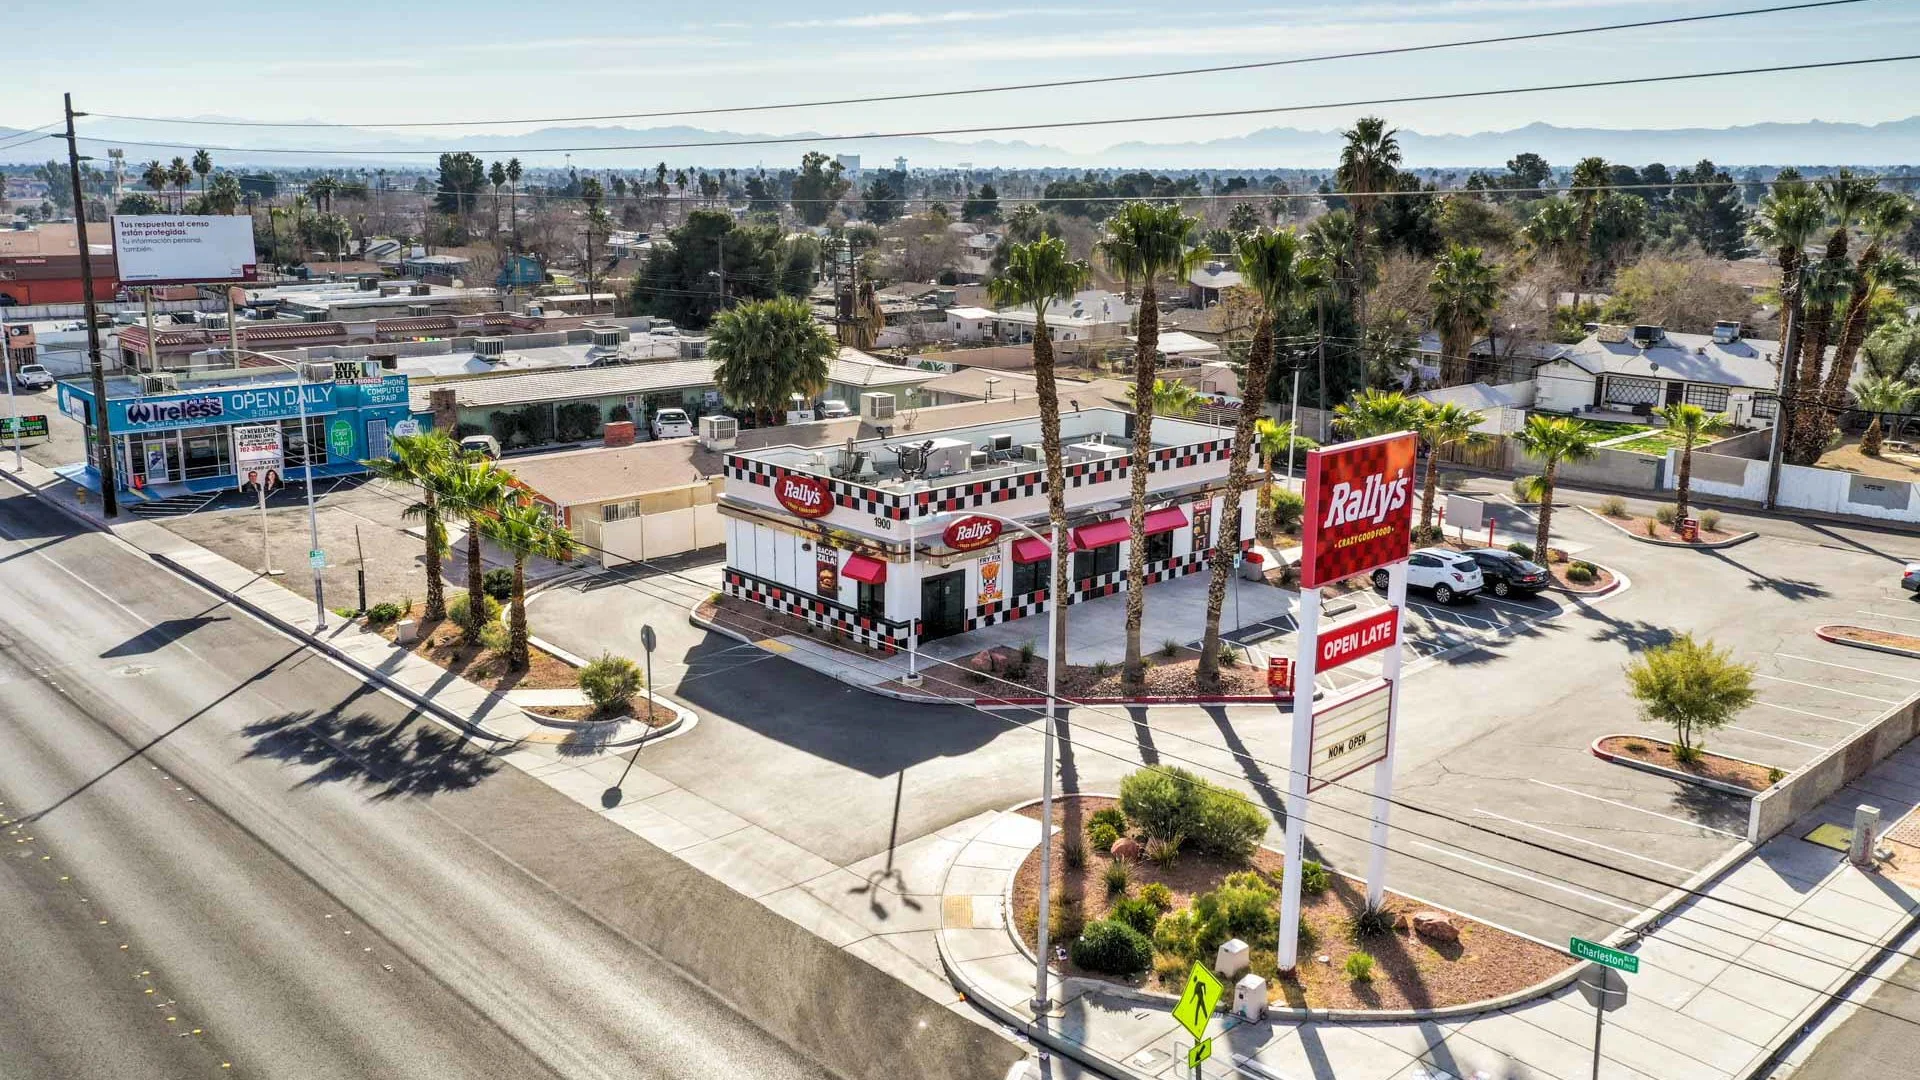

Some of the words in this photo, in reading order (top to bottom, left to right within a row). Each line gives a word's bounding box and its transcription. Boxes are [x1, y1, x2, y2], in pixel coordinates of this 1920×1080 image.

[120, 221, 133, 229] Tus
[134, 221, 175, 229] respuestas
[131, 236, 172, 244] información
[334, 362, 356, 371] WE
[334, 370, 360, 379] BUY
[367, 386, 405, 396] COMPUTER
[231, 391, 280, 410] OPEN
[284, 386, 333, 406] DAILY
[371, 393, 397, 403] REPAIR
[783, 480, 821, 506] Rally's
[1323, 468, 1409, 529] Rally's
[874, 517, 891, 530] 1900
[955, 520, 994, 541] Rally's
[817, 546, 838, 558] BACON
[817, 553, 837, 566] ZILLA!
[1323, 634, 1359, 661] OPEN
[1361, 620, 1392, 646] LATE
[1328, 742, 1345, 759] NOW
[1348, 733, 1367, 750] OPEN
[1577, 942, 1624, 967] Charleston
[1623, 955, 1637, 964] BLVD
